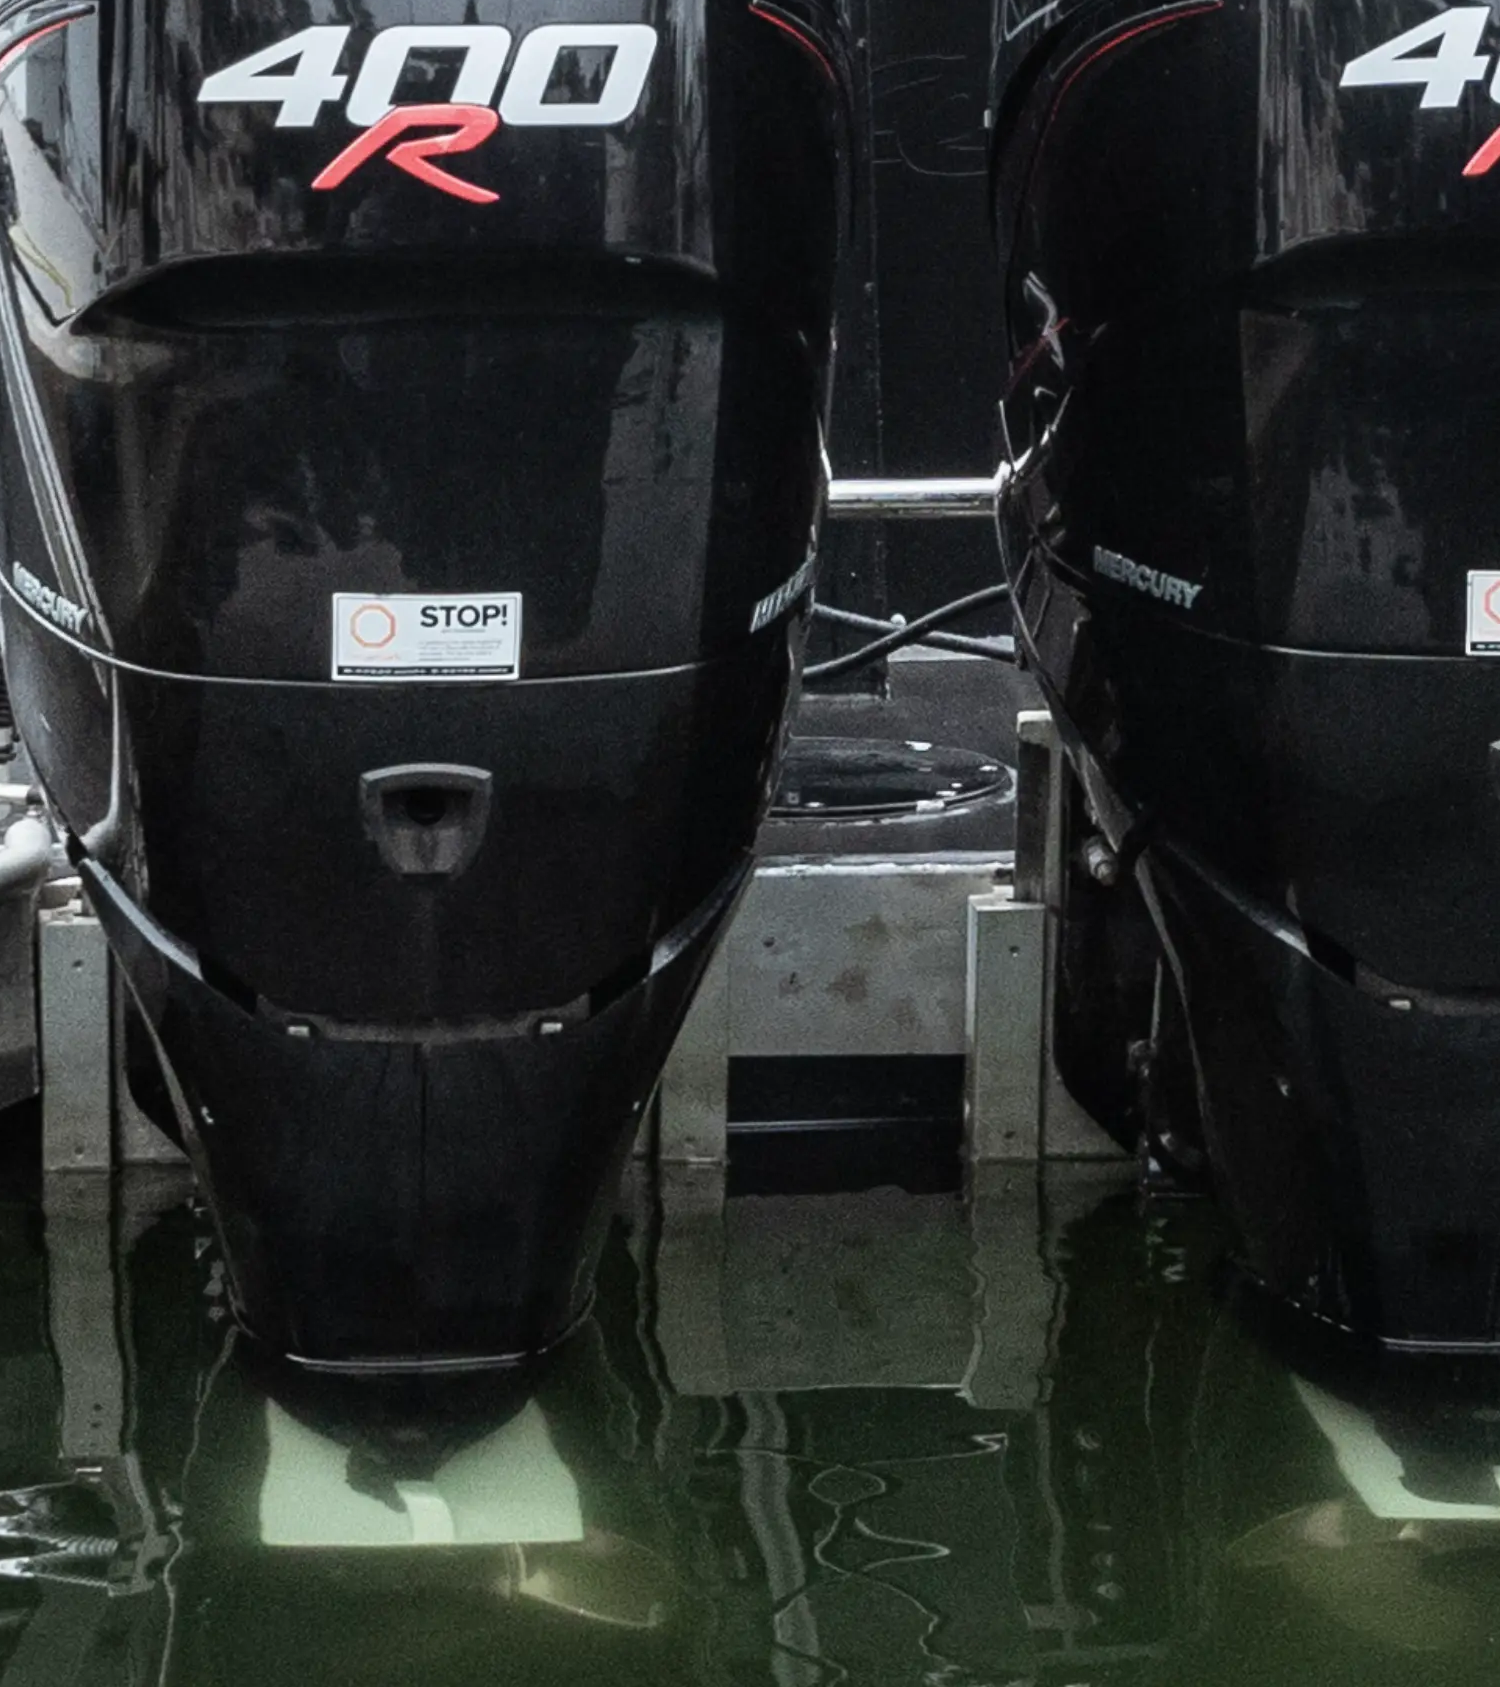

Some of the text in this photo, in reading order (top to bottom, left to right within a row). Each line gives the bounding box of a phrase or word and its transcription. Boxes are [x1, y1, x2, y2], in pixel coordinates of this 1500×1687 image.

[197, 22, 658, 128] 400
[311, 103, 501, 204] R
[419, 603, 508, 628] STOP!
